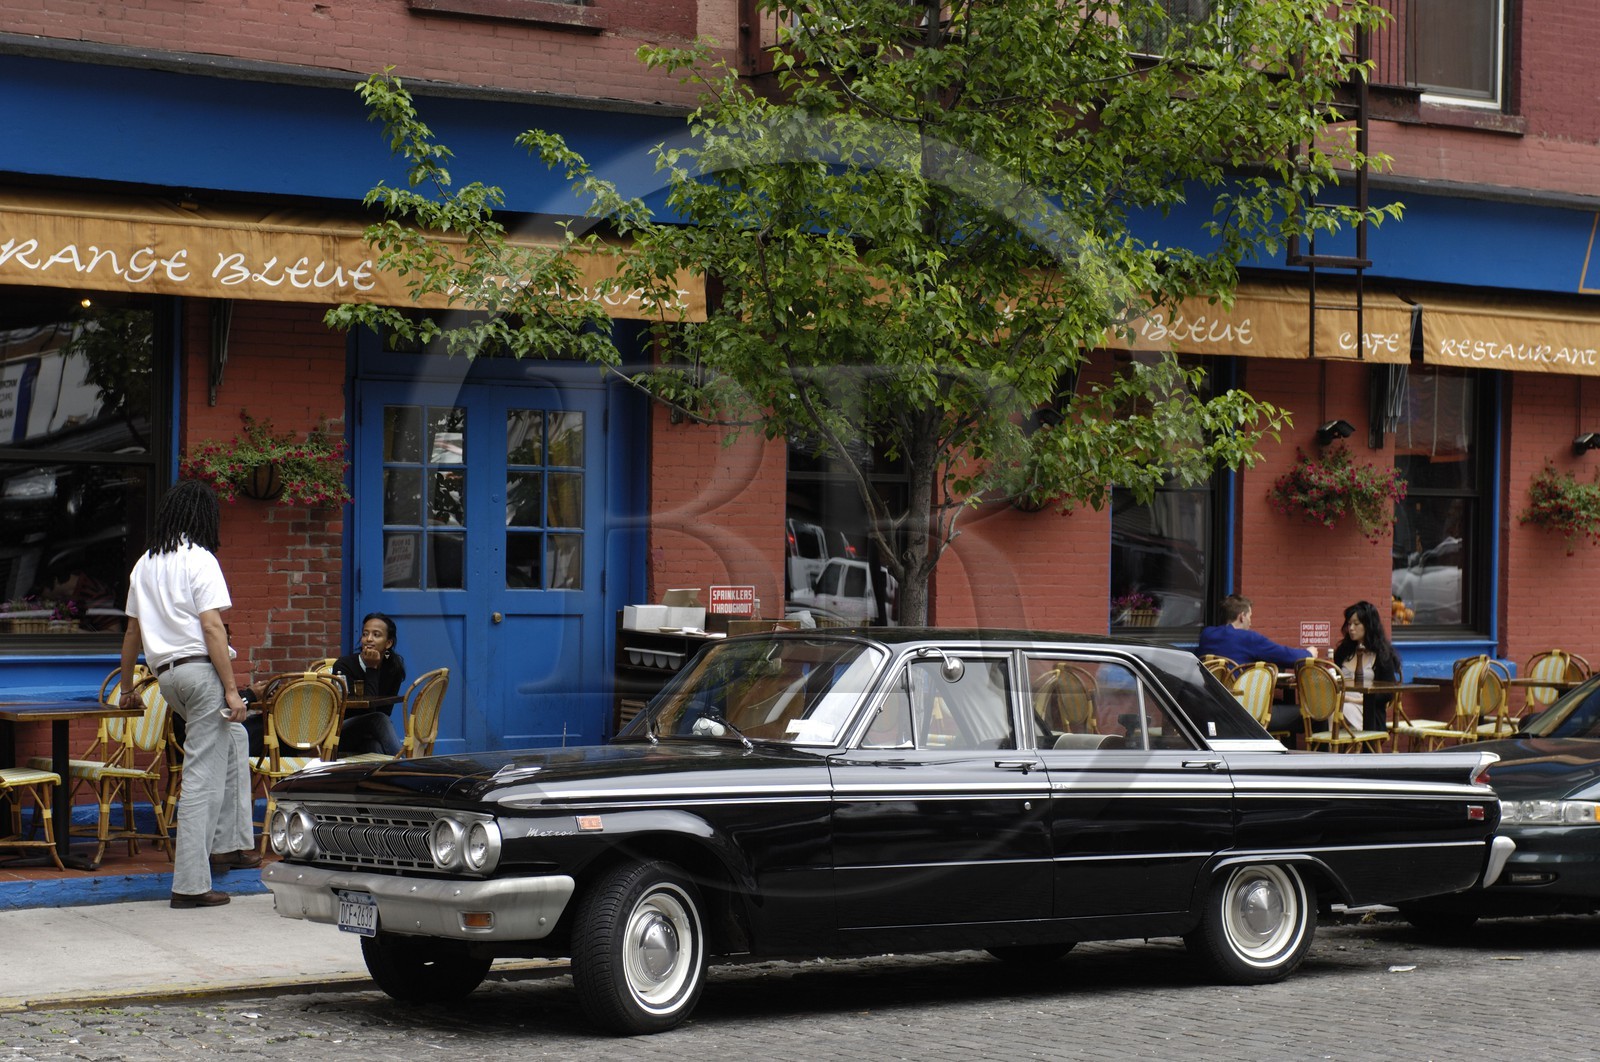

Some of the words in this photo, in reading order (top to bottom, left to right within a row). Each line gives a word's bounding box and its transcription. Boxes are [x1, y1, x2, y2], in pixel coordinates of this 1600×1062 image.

[212, 252, 375, 291] BLEUE
[1141, 313, 1253, 345] BLEUE
[1338, 331, 1400, 355] CAFE
[1440, 338, 1598, 366] RESTAURANT
[712, 589, 753, 600] SPRINKLERS
[712, 603, 753, 614] THROUGHOUT
